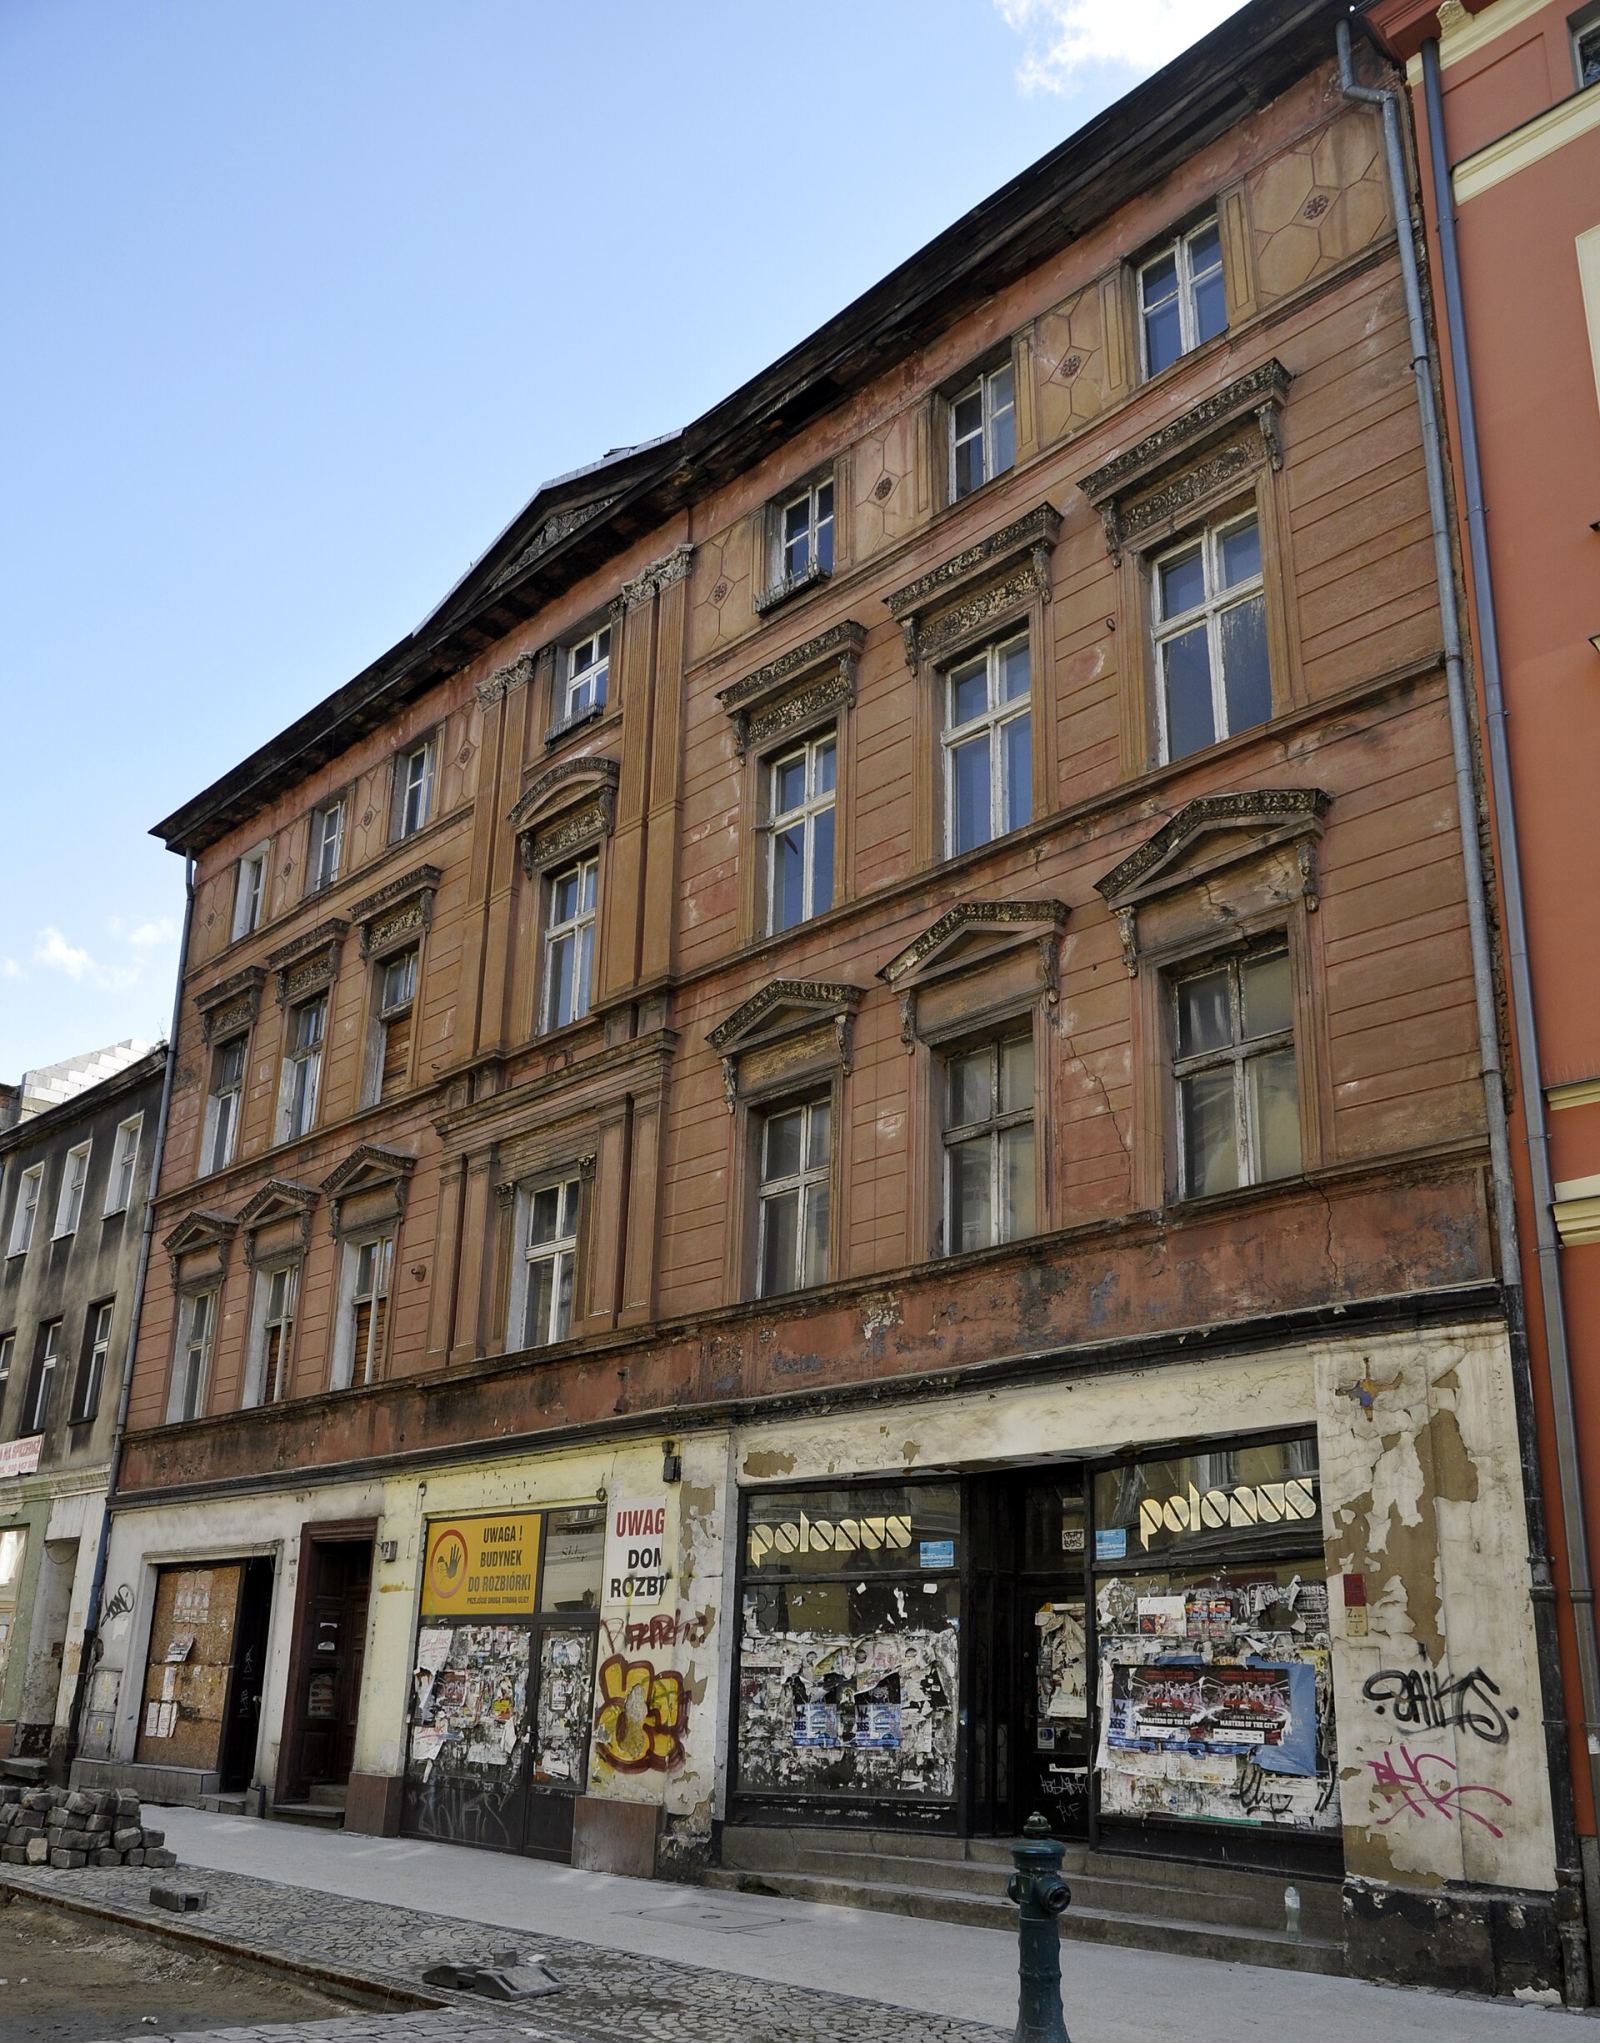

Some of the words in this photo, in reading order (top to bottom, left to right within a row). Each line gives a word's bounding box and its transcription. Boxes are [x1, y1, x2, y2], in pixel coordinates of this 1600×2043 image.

[483, 1526, 516, 1543] UWAGA
[480, 1550, 522, 1568] BUDYNEK
[468, 1577, 481, 1593] DO
[482, 1572, 531, 1593] ROZBIÓRKI
